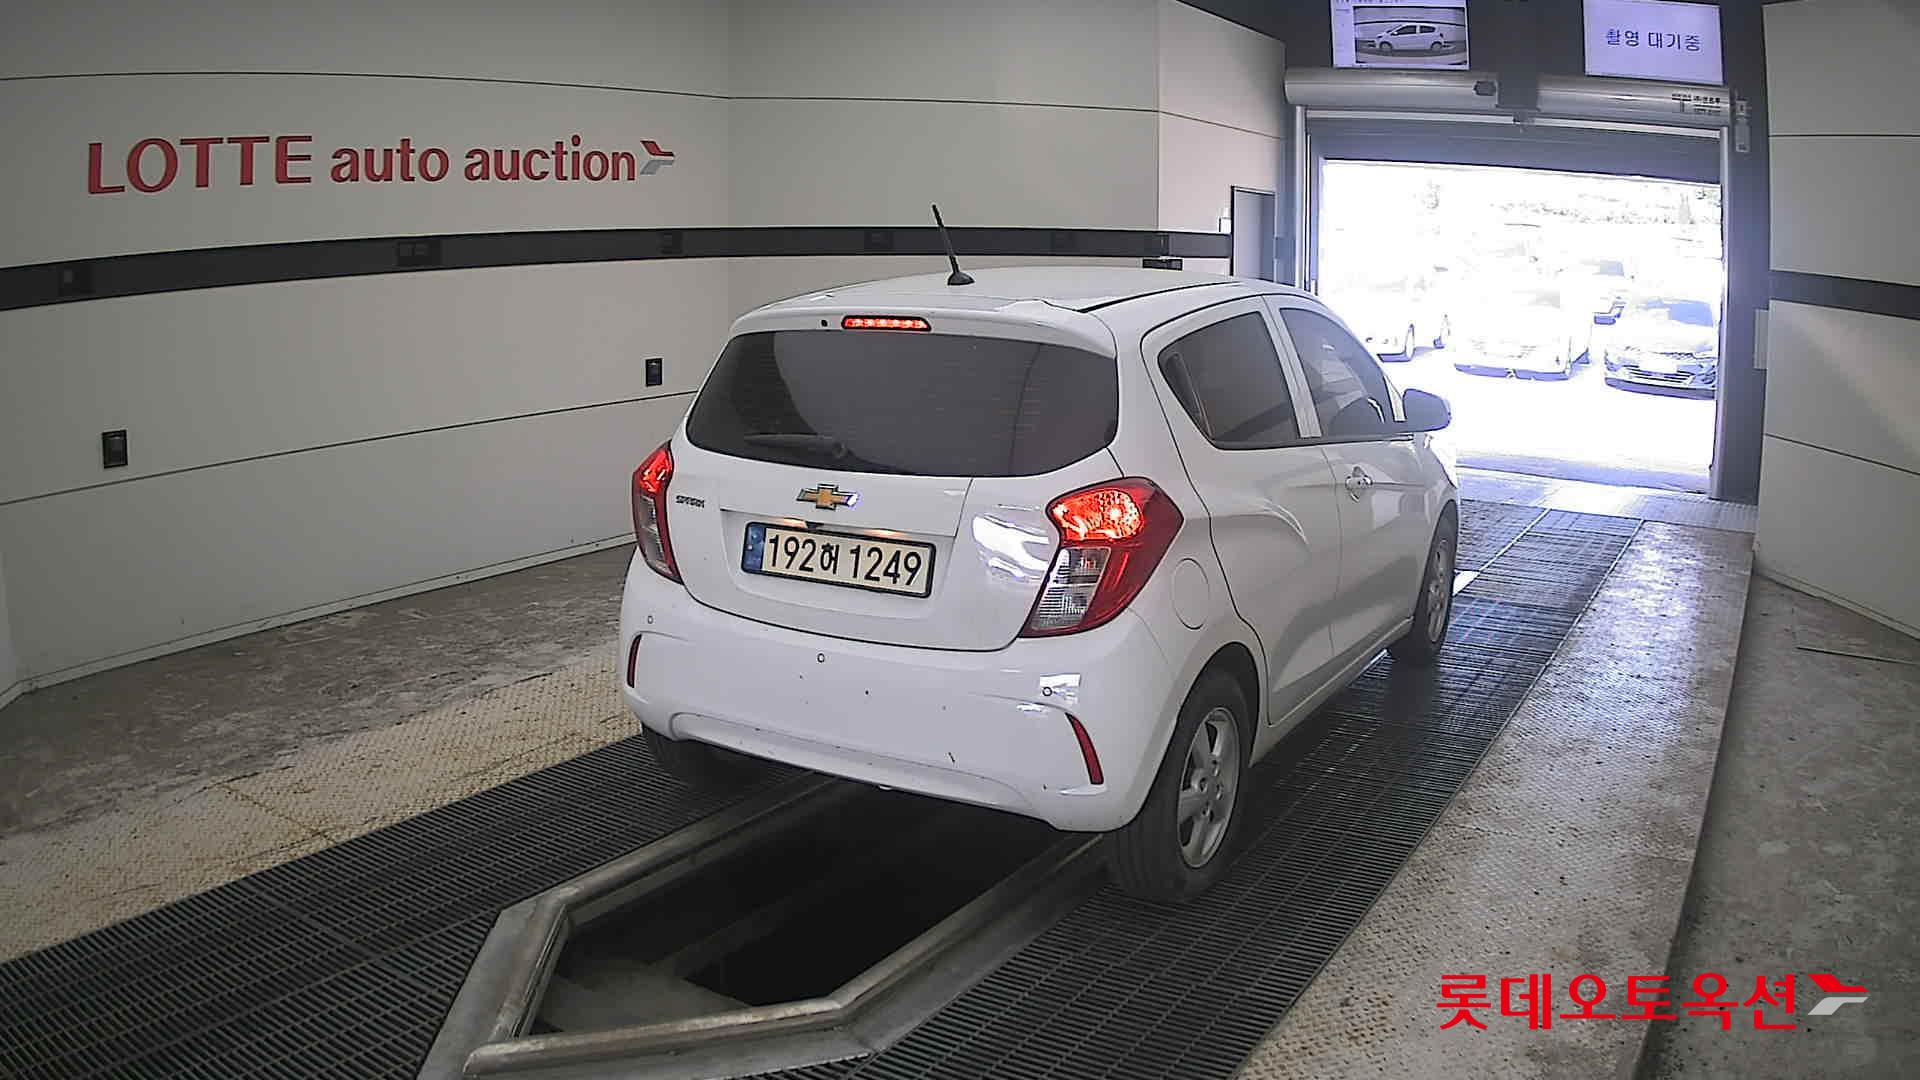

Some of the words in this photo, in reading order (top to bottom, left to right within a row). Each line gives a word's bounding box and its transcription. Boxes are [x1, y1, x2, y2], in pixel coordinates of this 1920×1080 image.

[1606, 28, 1640, 47] 촬영
[1647, 31, 1701, 52] 대기중
[88, 135, 313, 194] LOTTE
[330, 138, 449, 182] auto
[463, 134, 637, 182] auction
[768, 533, 839, 575] 192허
[850, 544, 922, 586] 1249
